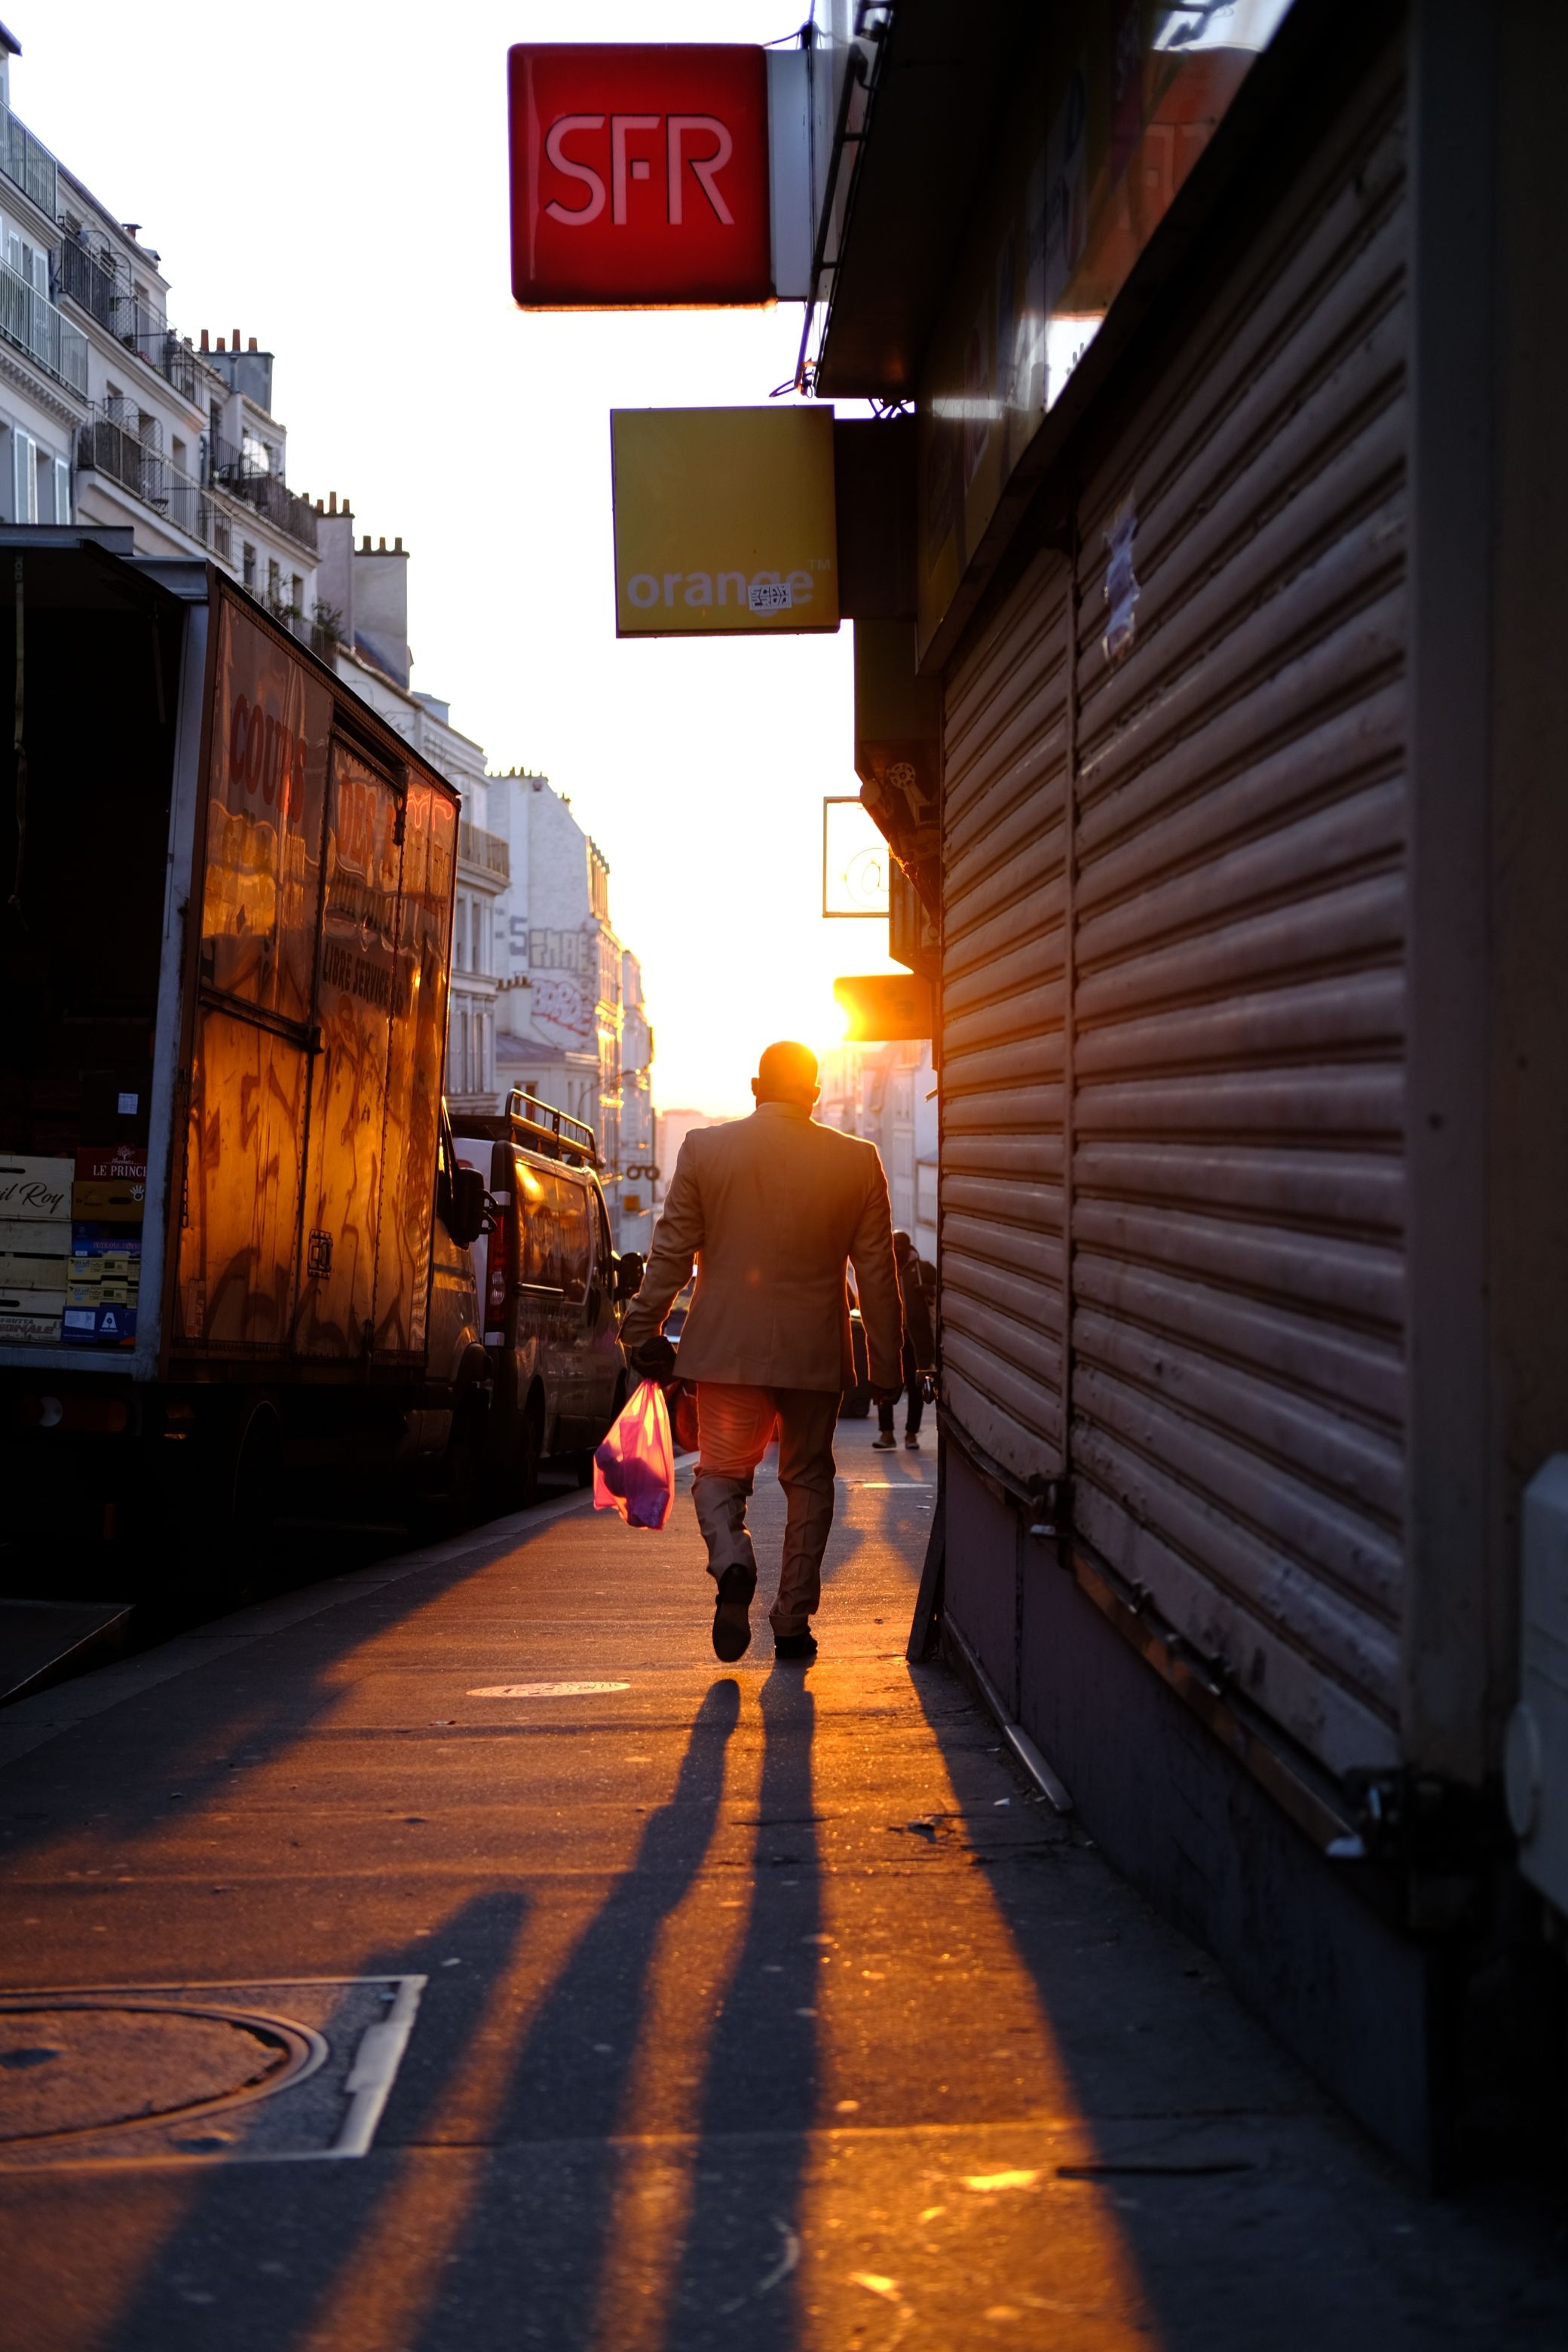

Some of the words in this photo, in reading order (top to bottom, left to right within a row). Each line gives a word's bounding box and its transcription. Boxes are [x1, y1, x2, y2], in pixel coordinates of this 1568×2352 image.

[544, 113, 735, 225] SFR
[626, 569, 813, 617] orange
[323, 942, 352, 992] LIBRE
[352, 957, 390, 1010] SERVICE
[93, 1165, 107, 1177] LE
[0, 1183, 18, 1201] il
[19, 1182, 65, 1214] Roy
